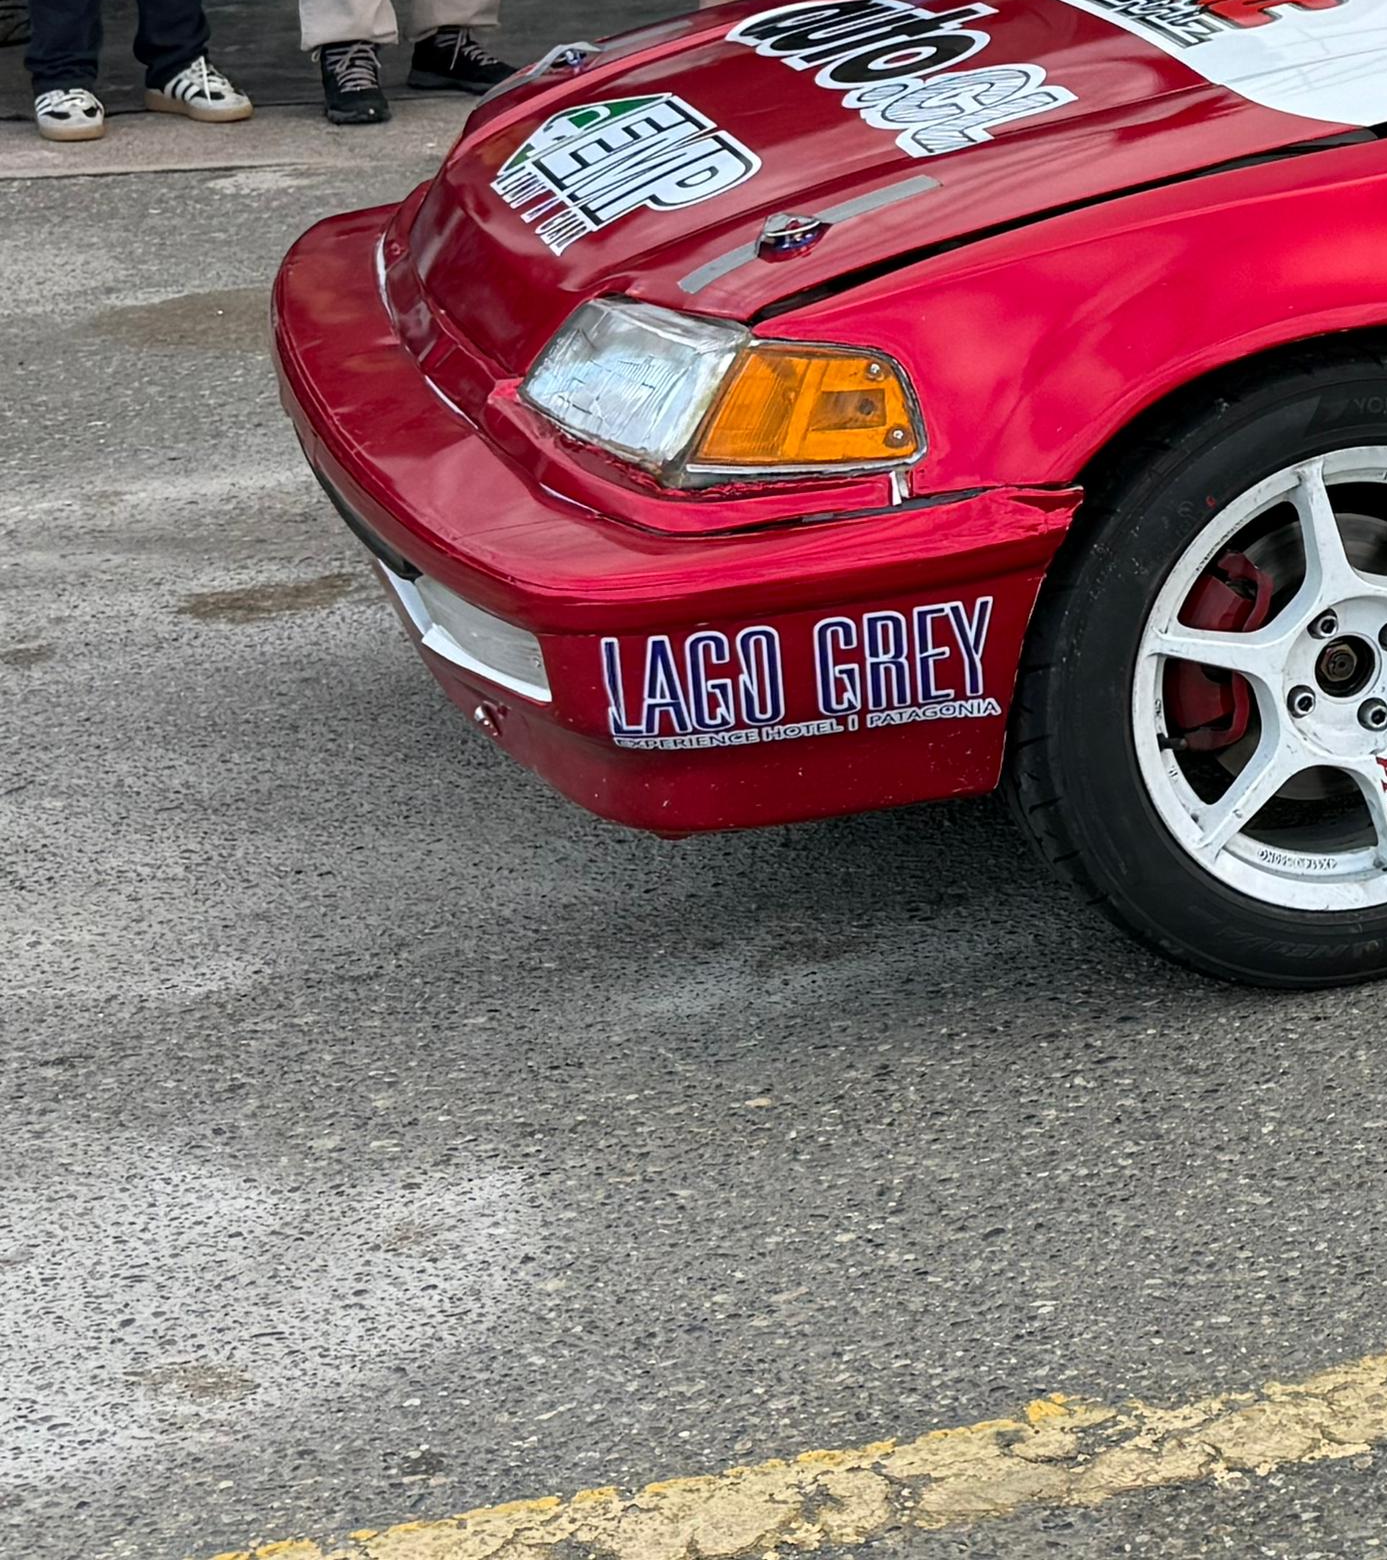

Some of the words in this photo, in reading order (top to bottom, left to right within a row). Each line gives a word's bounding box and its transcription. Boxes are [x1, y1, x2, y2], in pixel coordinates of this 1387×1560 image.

[532, 97, 762, 228] EMP
[601, 625, 785, 737] LAGO
[814, 597, 993, 716] GREY
[616, 728, 761, 750] EXPERIENCE
[762, 721, 843, 743] HOTEL
[867, 698, 1001, 728] PATAGONIA
